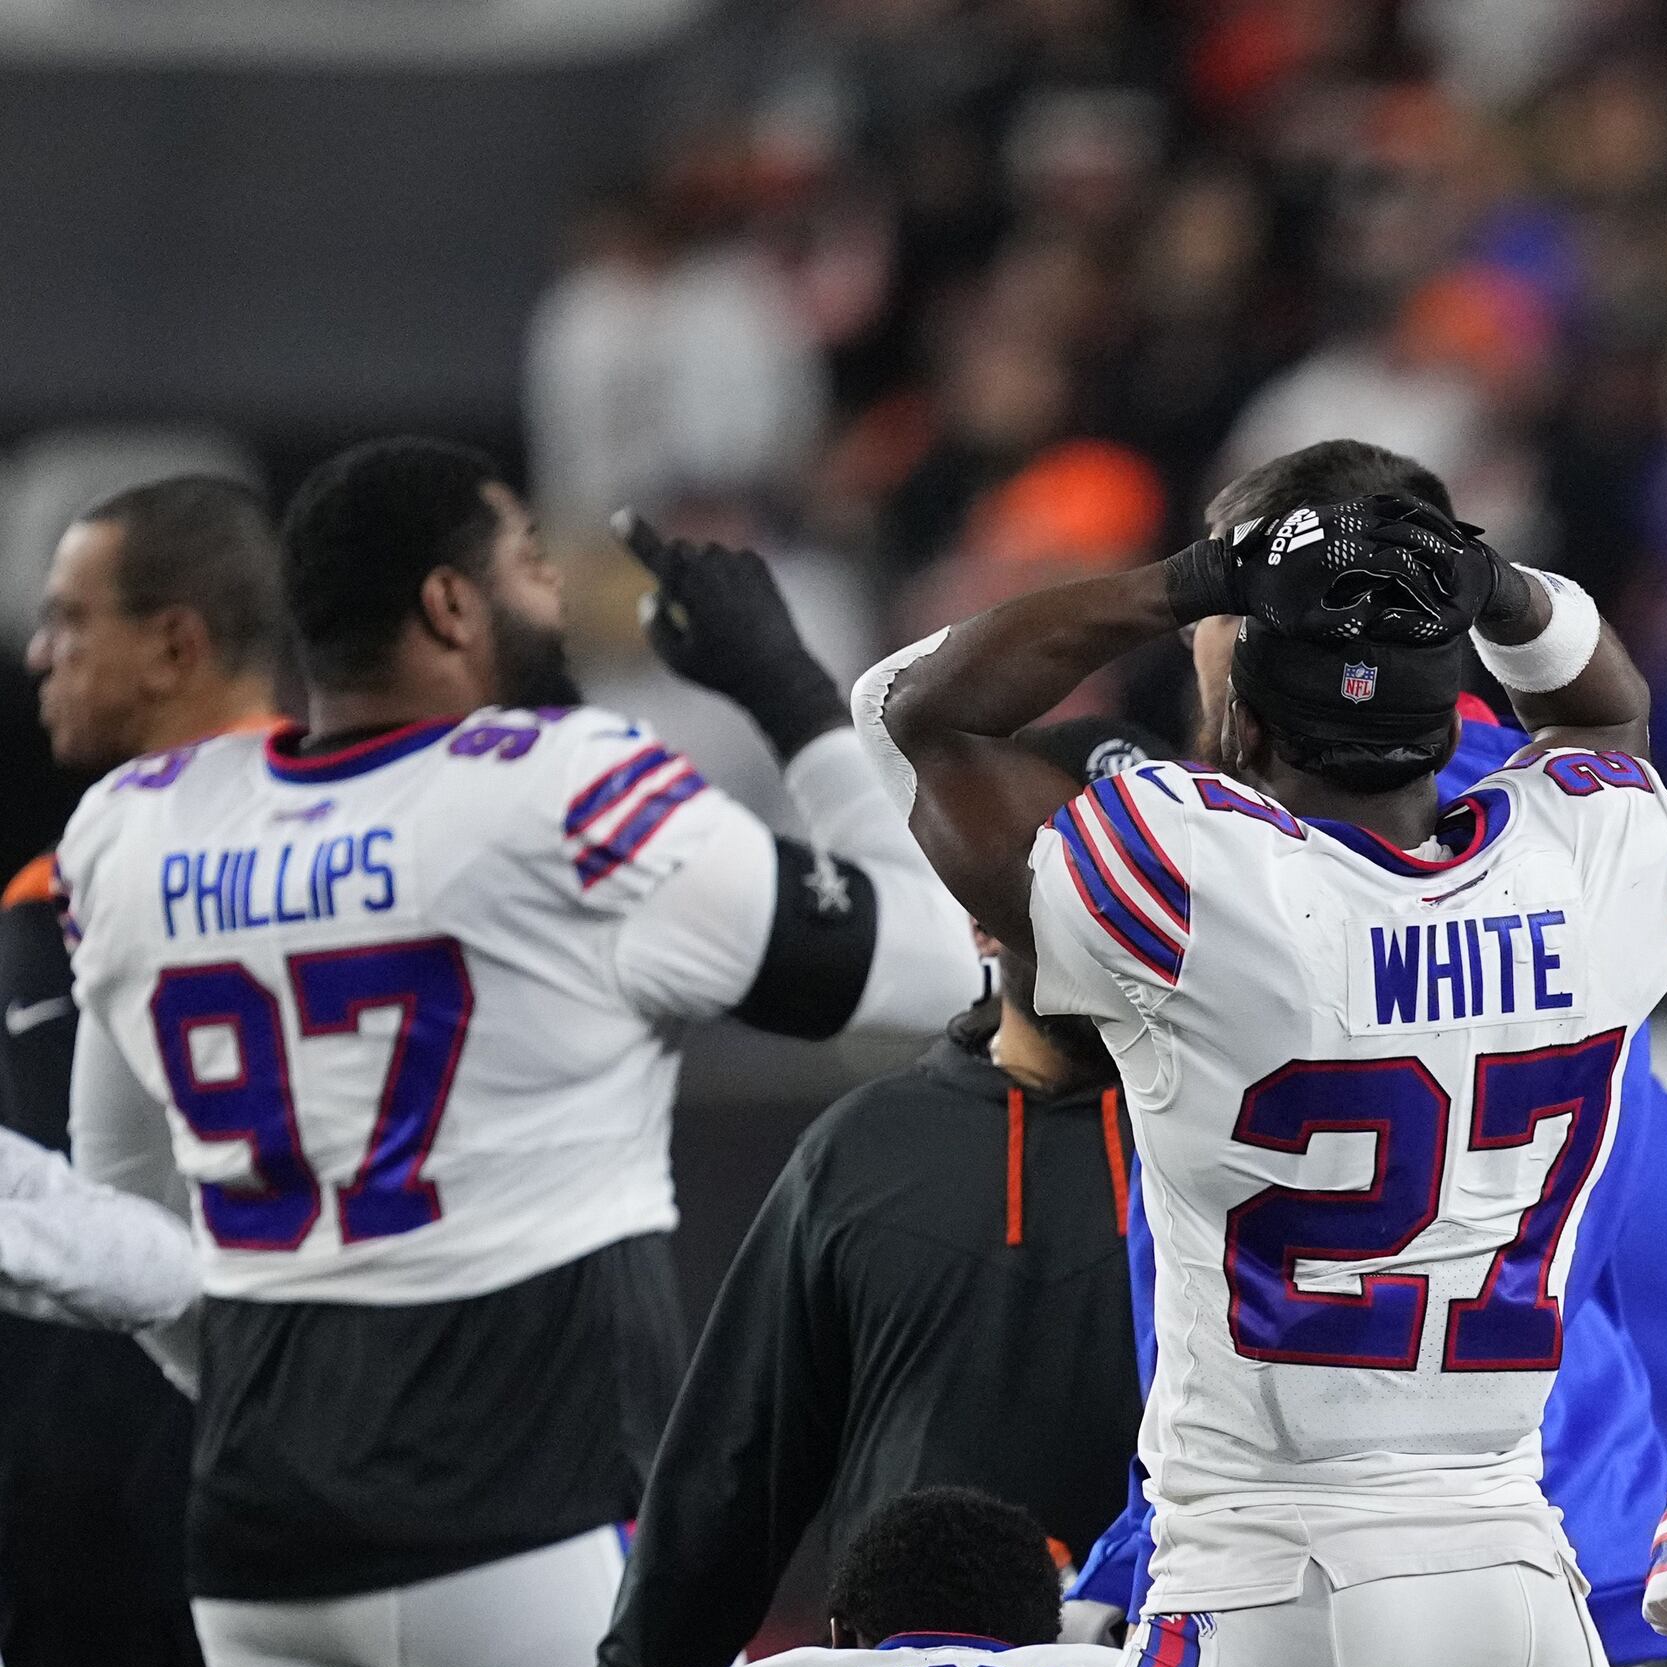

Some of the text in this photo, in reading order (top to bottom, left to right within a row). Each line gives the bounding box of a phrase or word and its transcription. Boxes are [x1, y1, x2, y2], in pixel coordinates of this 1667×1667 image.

[1268, 508, 1310, 566] adidas
[1346, 679, 1371, 697] NFL
[161, 827, 396, 938] PHILLIPS
[1371, 911, 1573, 1025] WHITE
[150, 936, 475, 1251] 97
[1223, 1025, 1627, 1372] 27
